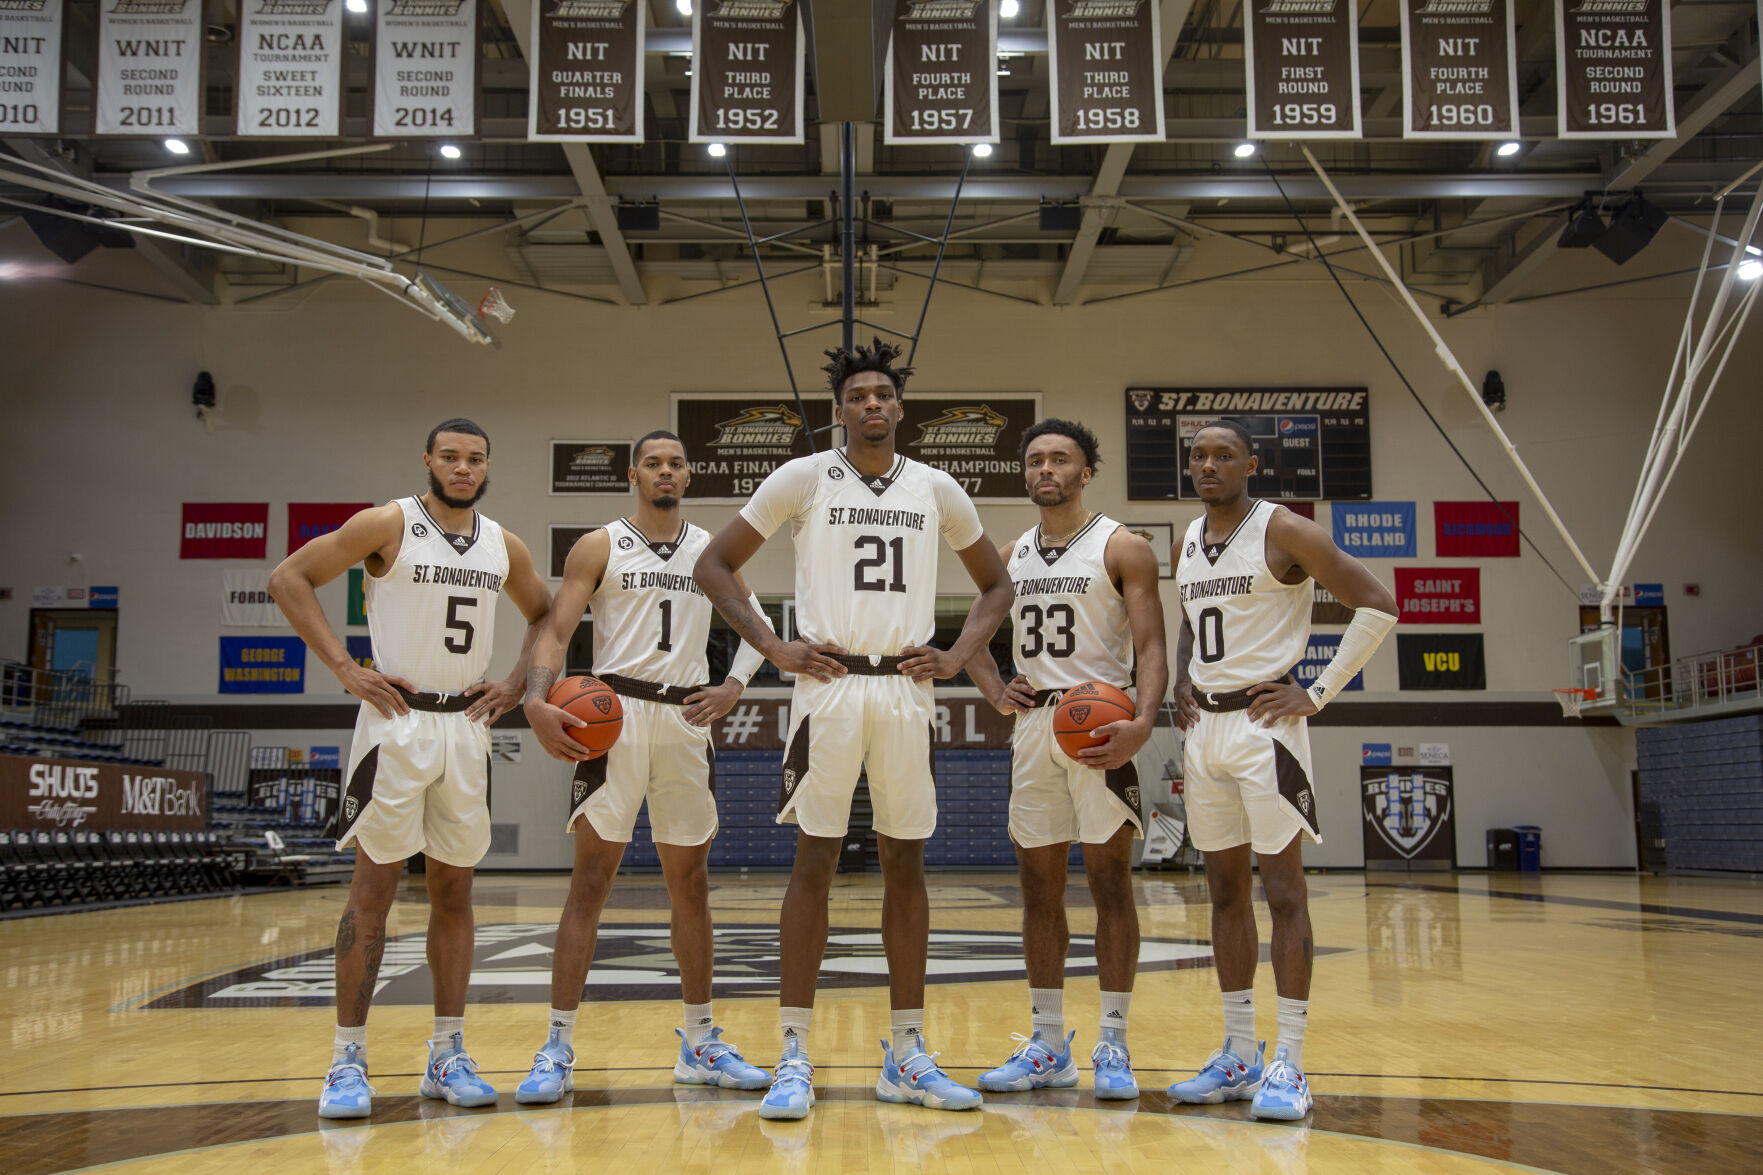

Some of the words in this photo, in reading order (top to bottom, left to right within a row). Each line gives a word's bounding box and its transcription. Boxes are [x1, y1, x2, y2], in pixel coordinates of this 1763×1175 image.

[0, 0, 44, 10] NNIES
[1271, 2, 1332, 12] BONNIES
[1427, 2, 1489, 12] BONNIES
[1581, 2, 1645, 11] BONNIES
[558, 7, 619, 17] BONNIES
[718, 7, 780, 17] BONNIES
[911, 8, 972, 18] BONNIES
[1073, 7, 1135, 17] BONNIES
[577, 21, 624, 29] BASKETBALL
[713, 20, 736, 28] MEN'S
[737, 21, 784, 29] BASKETBALL
[929, 22, 976, 30] BASKETBALL
[1069, 21, 1091, 29] MEN'S
[1092, 20, 1139, 28] BASKETBALL
[1289, 16, 1336, 24] BASKETBALL
[259, 34, 325, 50] NCAA
[1580, 29, 1648, 46] NCAA
[0, 37, 45, 54] NIT
[116, 40, 186, 57] WNIT
[392, 42, 460, 58] WNIT
[567, 43, 609, 60] NIT
[728, 43, 769, 60] NIT
[1085, 42, 1125, 60] NIT
[1281, 38, 1322, 55] NIT
[1438, 38, 1479, 56] NIT
[253, 54, 329, 62] TOURNAMENT
[921, 44, 962, 61] NIT
[1575, 49, 1653, 58] TOURNAMENT
[0, 66, 37, 77] COND
[121, 70, 178, 80] SECOND
[263, 71, 318, 81] SWEET
[397, 71, 453, 82] SECOND
[552, 71, 622, 83] QUARTER
[726, 72, 770, 83] THIRD
[1085, 71, 1128, 83] THIRD
[1281, 67, 1324, 79] FIRST
[1430, 67, 1488, 79] FOURTH
[1586, 67, 1644, 78] SECOND
[912, 73, 971, 85] FOURTH
[0, 82, 34, 92] UND
[124, 84, 174, 95] ROUND
[257, 85, 322, 96] SIXTEEN
[400, 86, 450, 96] ROUND
[560, 86, 614, 98] FINALS
[724, 87, 771, 98] PLACE
[919, 88, 965, 99] PLACE
[1083, 86, 1131, 98] PLACE
[1278, 82, 1328, 93] ROUND
[1436, 82, 1484, 94] PLACE
[1590, 82, 1641, 93] ROUND
[120, 107, 175, 126] 2011
[259, 108, 319, 127] 2012
[395, 108, 453, 127] 2014
[557, 108, 615, 128] 1951
[716, 108, 778, 129] 1952
[911, 109, 973, 129] 1957
[1076, 108, 1139, 129] 1958
[1273, 104, 1336, 124] 1959
[1430, 105, 1492, 124] 1960
[1588, 103, 1646, 124] 1961
[1181, 420, 1209, 428] SHUL
[1294, 422, 1316, 431] pepsi
[720, 434, 792, 444] BONNIES
[922, 433, 995, 444] BONNIES
[1282, 438, 1309, 448] GUEST
[946, 447, 995, 455] BASKETBALL
[687, 461, 729, 474] NCAA
[733, 478, 764, 494] 19
[958, 478, 982, 493] 77
[829, 507, 845, 525] ST.
[848, 507, 925, 531] BONAVENTURE
[1345, 513, 1403, 527] RHODE
[185, 522, 264, 539] DAVIDSON
[300, 524, 340, 538] DAY
[1443, 523, 1512, 536] RICHMOND
[1344, 532, 1405, 546] ISLAND
[854, 535, 906, 593] 21
[413, 564, 430, 583] ST.
[433, 565, 502, 593] BONAVENTURE
[622, 572, 637, 590] ST.
[1020, 577, 1091, 596] BONAVENTURE
[1180, 583, 1188, 603] ST.
[1190, 575, 1254, 601] BONAVENTURE
[1414, 579, 1462, 593] SAINT
[231, 591, 275, 604] FORDH
[1403, 599, 1475, 613] JOSEPH'S
[445, 596, 477, 655] 5
[657, 599, 672, 652] 1
[1020, 603, 1075, 659] 33
[1199, 607, 1225, 663] 0
[241, 648, 285, 662] GEORGE
[1306, 645, 1339, 660] AIN
[1423, 652, 1460, 671] VCU
[224, 668, 301, 682] WASHINGTON
[1070, 689, 1100, 698] adidas
[1371, 751, 1390, 760] pepsi
[1420, 752, 1448, 760] SENECA
[29, 763, 99, 798] SHULTS
[120, 775, 165, 815] M&T
[164, 778, 200, 816] Bank
